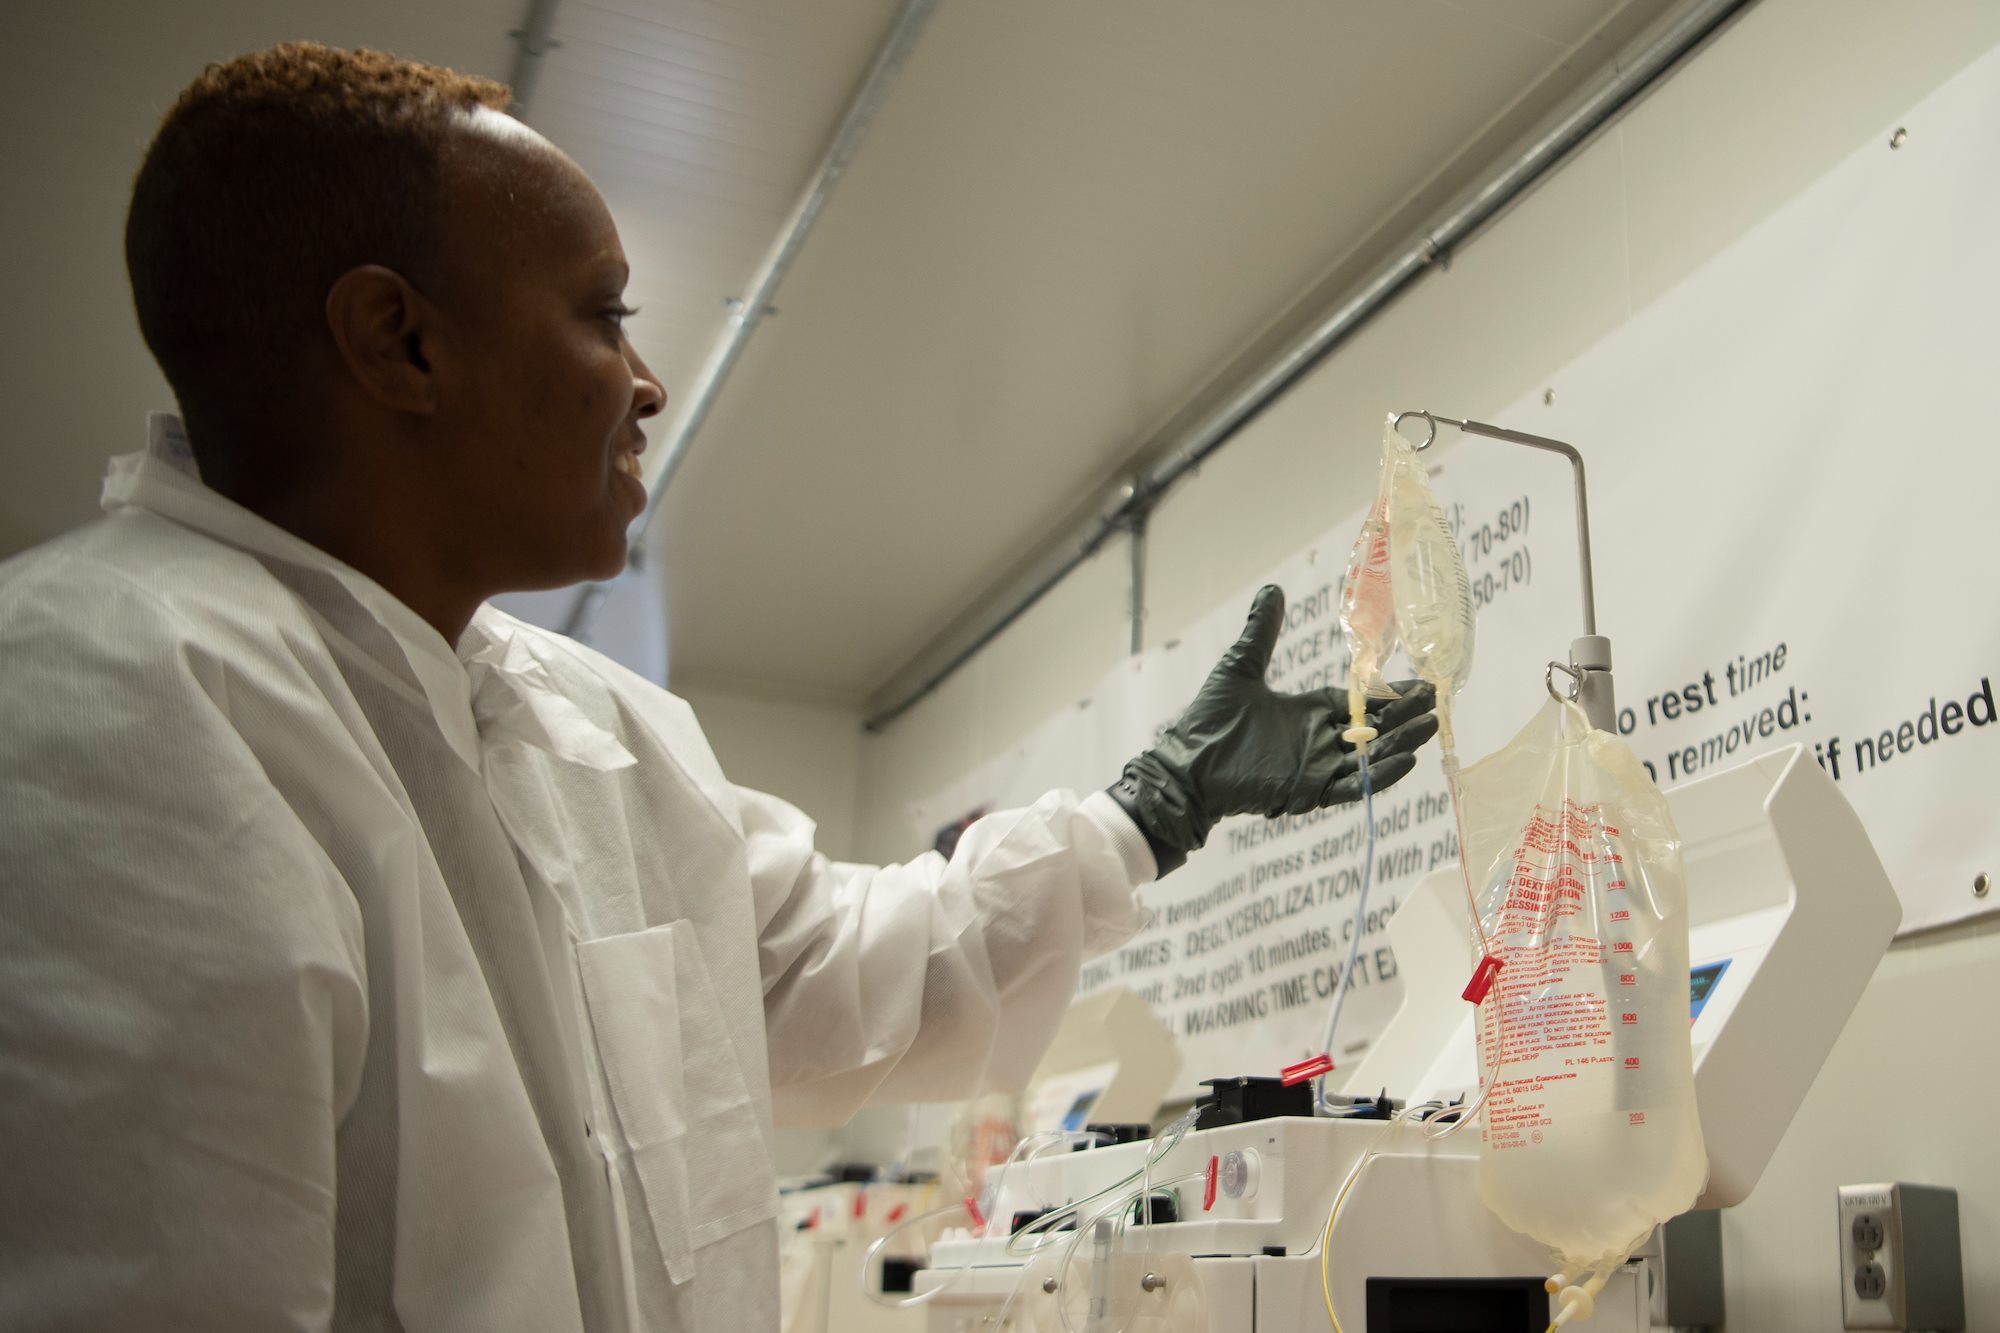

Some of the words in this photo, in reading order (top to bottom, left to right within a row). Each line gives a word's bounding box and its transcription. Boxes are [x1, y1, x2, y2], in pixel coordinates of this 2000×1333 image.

[1647, 671, 1718, 726] rest
[1726, 641, 1788, 698] time
[1667, 685, 1813, 781] removed:
[1854, 676, 1999, 775] needed
[1416, 790, 1450, 826] the
[1377, 841, 1424, 884] With
[1610, 911, 1629, 921] 1200
[1248, 943, 1266, 975] 10
[1613, 942, 1633, 951] 1000
[1620, 974, 1636, 984] 800
[1185, 987, 1269, 1036] WARMING
[1270, 972, 1311, 1012] TIME
[1624, 1057, 1640, 1067] 400
